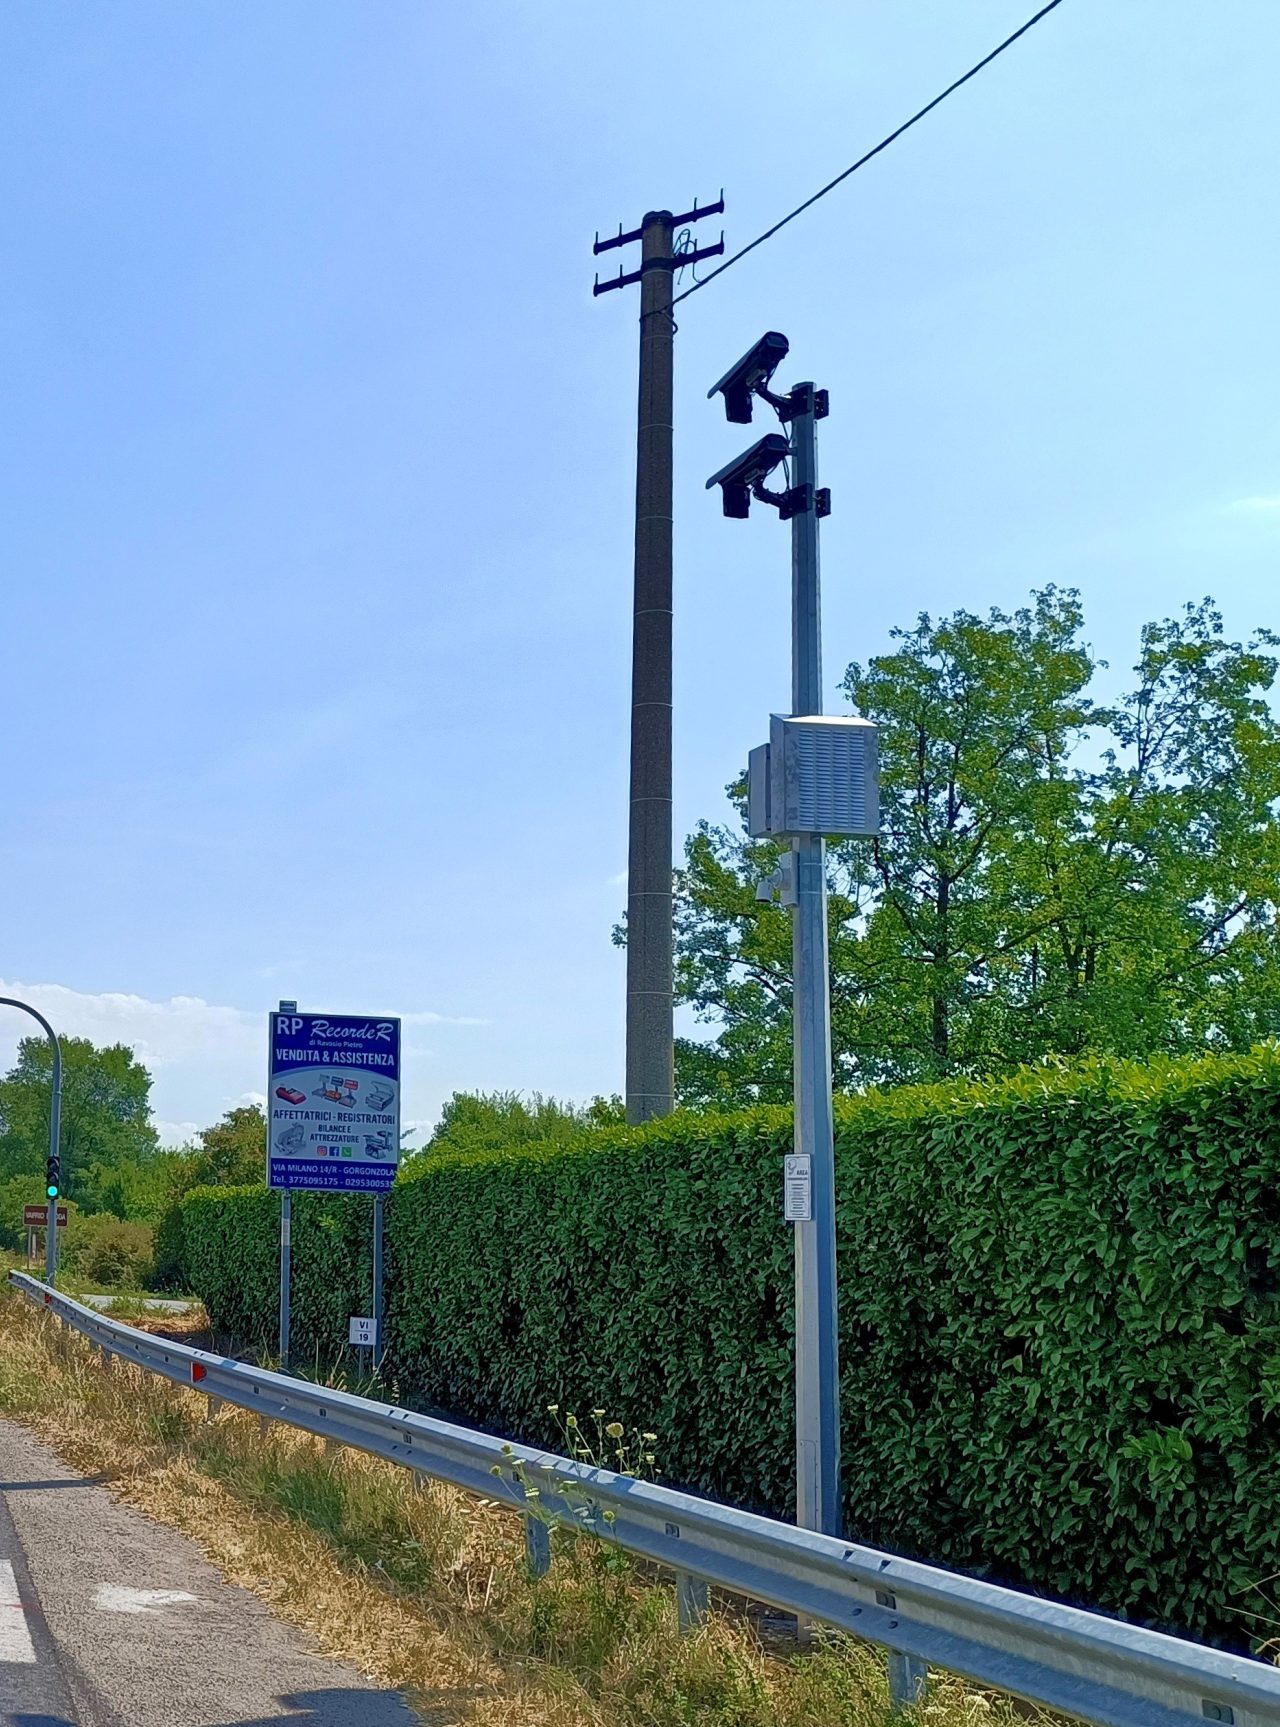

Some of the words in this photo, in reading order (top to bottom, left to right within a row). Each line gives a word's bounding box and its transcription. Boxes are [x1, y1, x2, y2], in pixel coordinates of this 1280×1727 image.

[277, 1017, 303, 1035] RP
[276, 1048, 320, 1062] VENDITA
[322, 1051, 330, 1062] &
[332, 1051, 395, 1066] ASSISTENZA
[273, 1109, 331, 1121] AFFETTATRICI
[337, 1112, 395, 1125] REGISTRATORI
[318, 1124, 345, 1133] BILANCE
[309, 1133, 360, 1143] ATTREZZATURE
[272, 1163, 286, 1171] VIA
[287, 1165, 318, 1173] MILANO
[343, 1166, 395, 1176] GORGONZOLA
[272, 1175, 286, 1183] Tel.
[288, 1176, 338, 1186] 3775095175
[359, 1333, 368, 1341] 19
